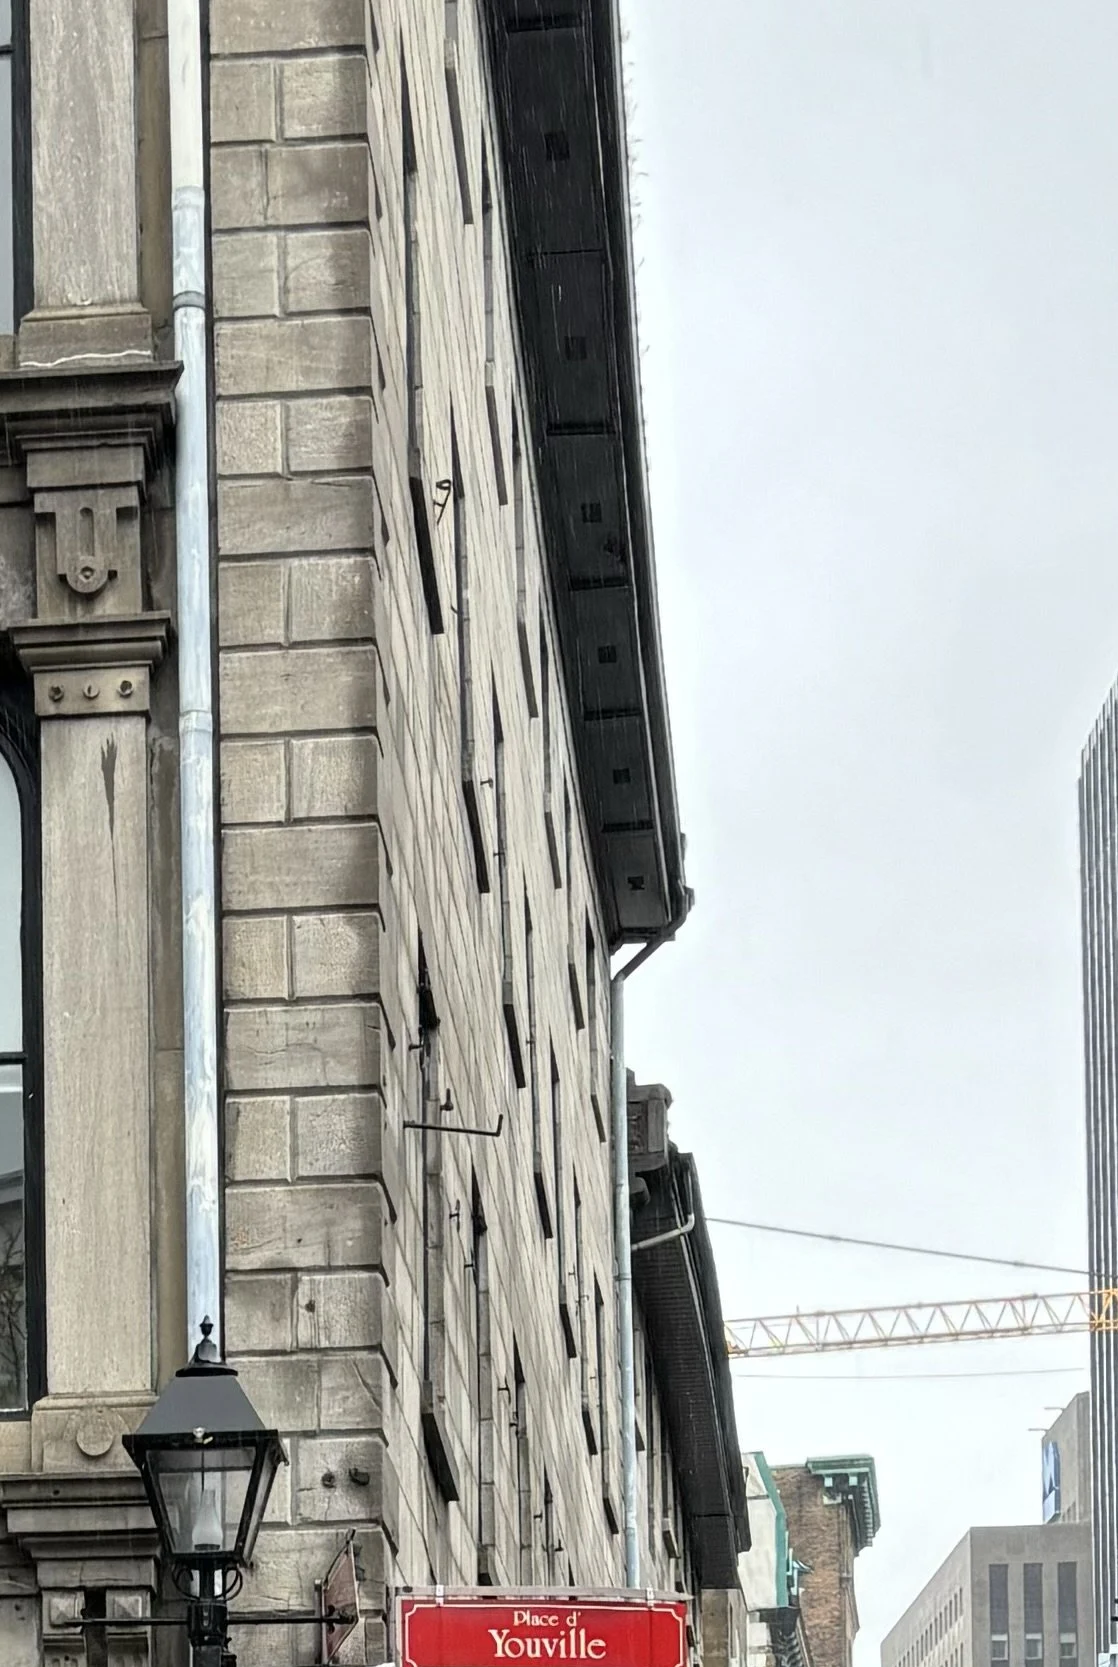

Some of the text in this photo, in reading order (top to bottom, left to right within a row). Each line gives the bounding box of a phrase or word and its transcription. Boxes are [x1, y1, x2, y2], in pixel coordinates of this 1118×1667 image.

[513, 1610, 582, 1627] Place d'
[488, 1628, 607, 1659] Youville
